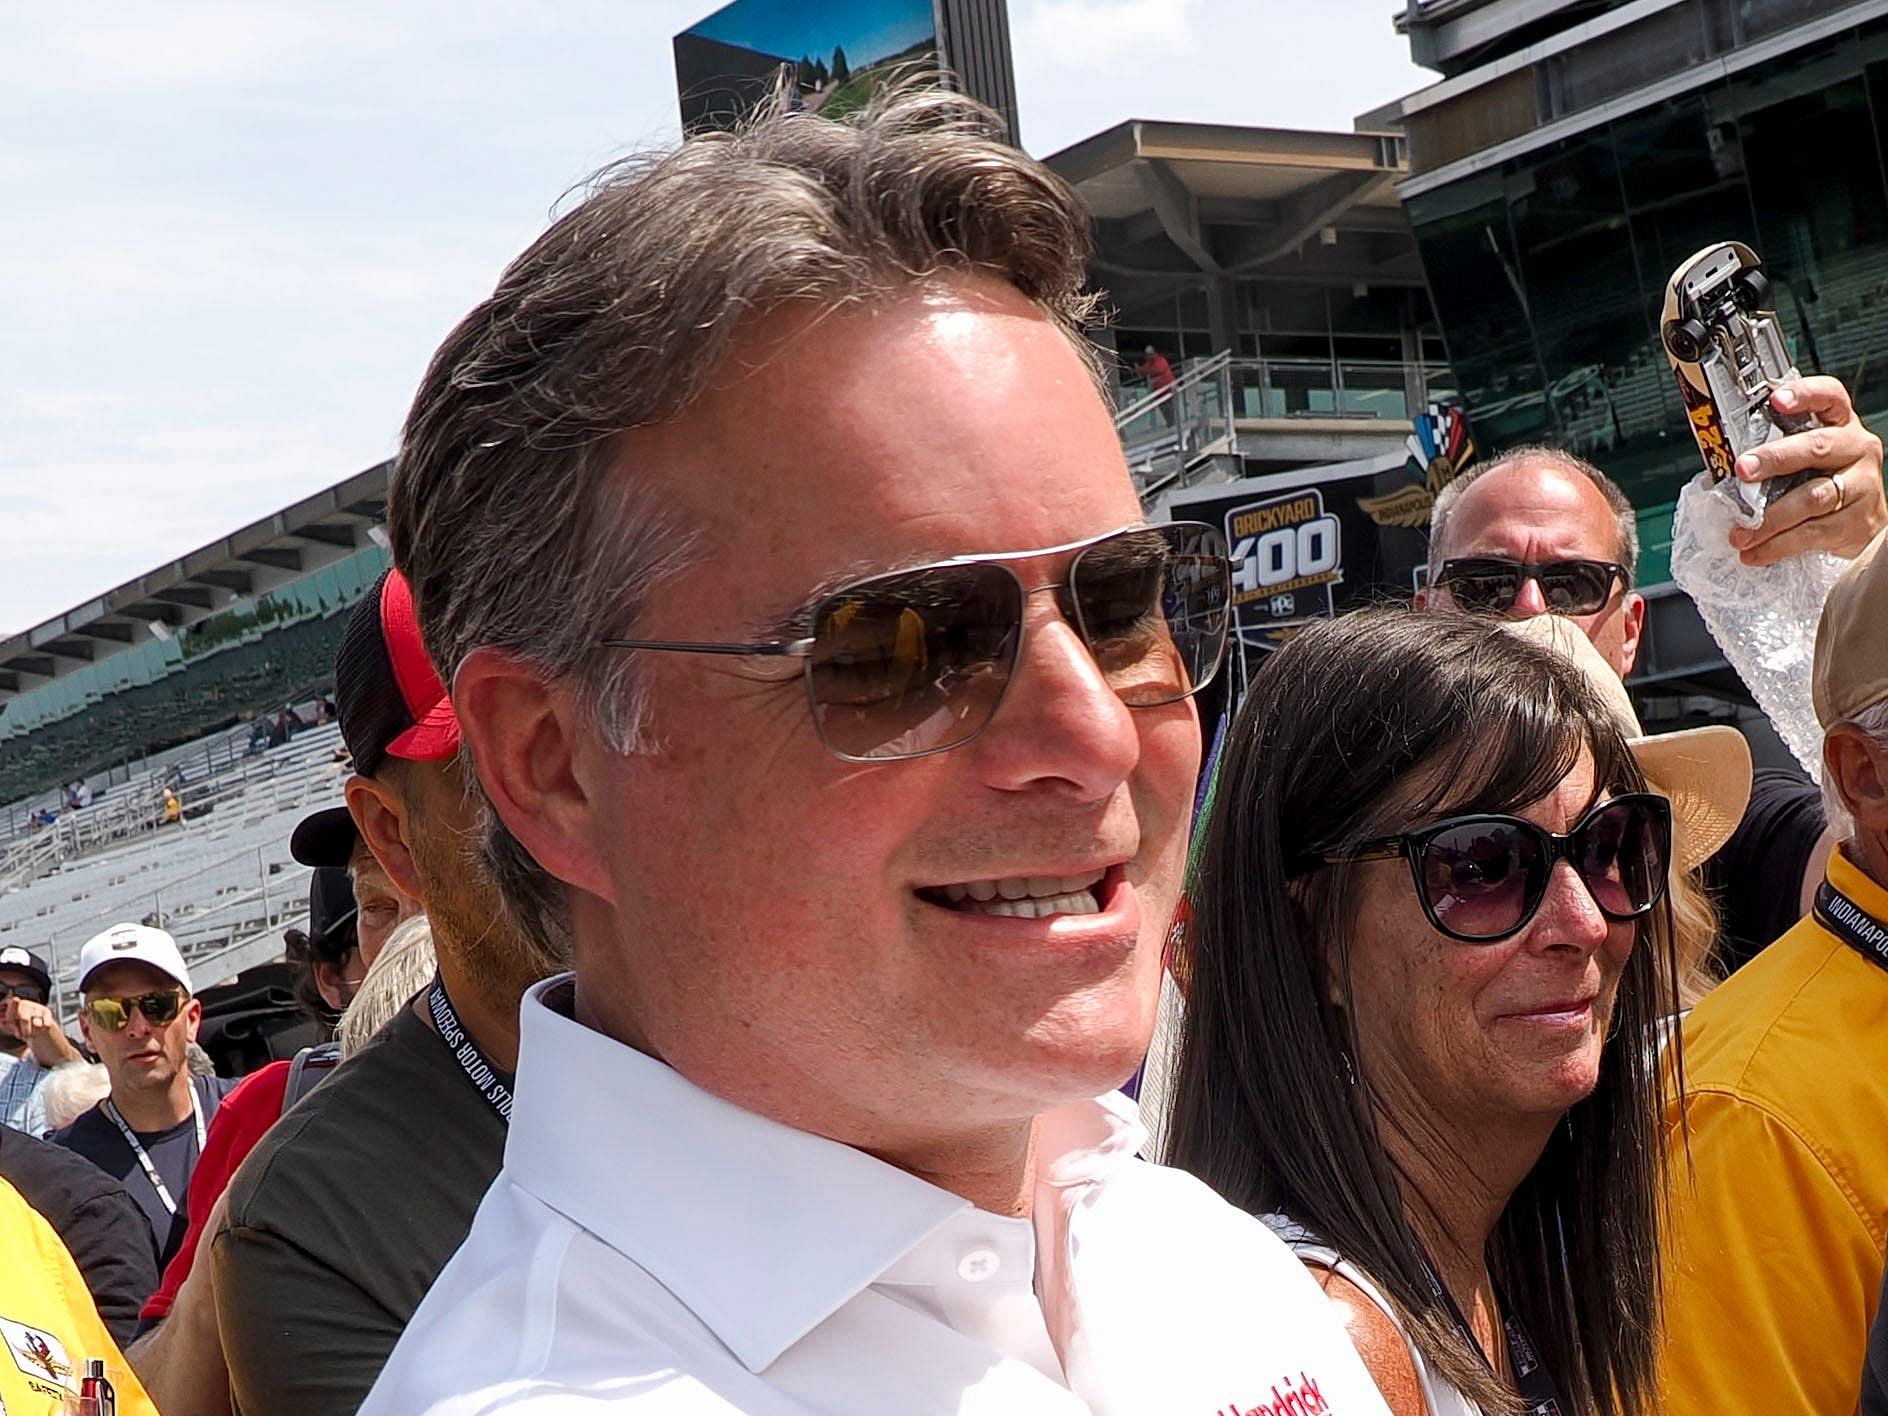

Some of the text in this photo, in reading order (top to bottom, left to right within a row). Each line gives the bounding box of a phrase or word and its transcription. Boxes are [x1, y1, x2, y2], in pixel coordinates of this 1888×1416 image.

[1234, 498, 1316, 537] BRICKYARD
[1232, 517, 1337, 593] 400
[456, 1042, 497, 1091] MOTOR
